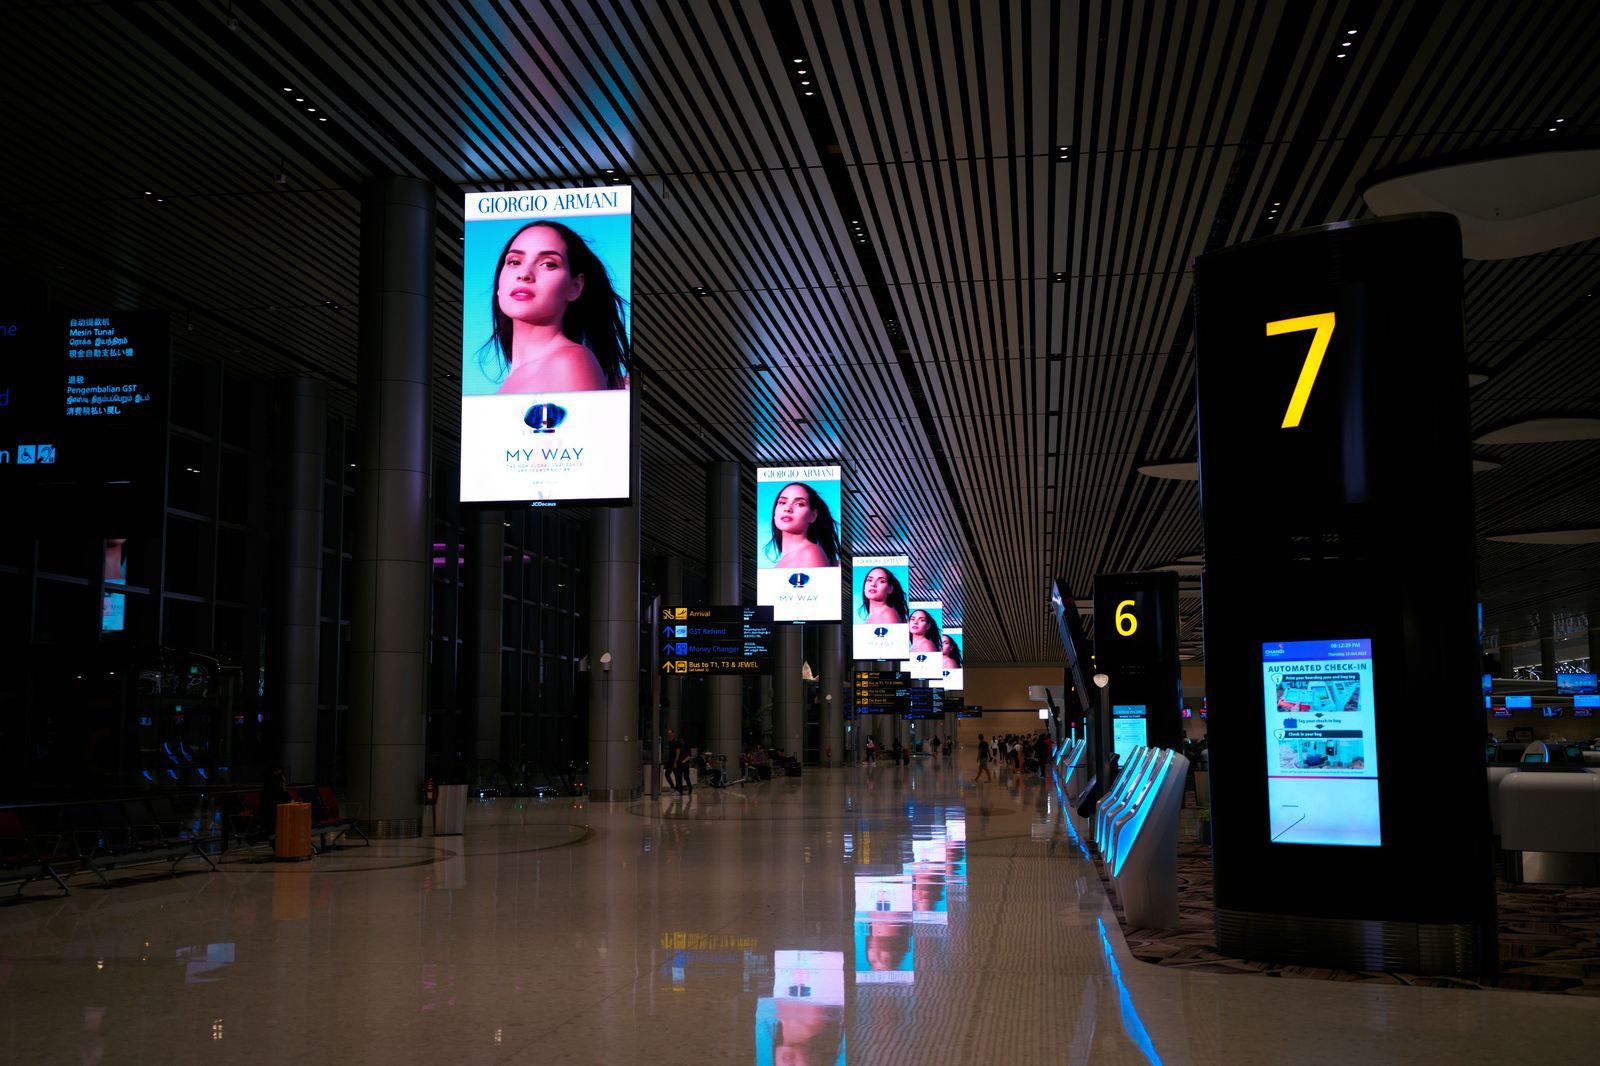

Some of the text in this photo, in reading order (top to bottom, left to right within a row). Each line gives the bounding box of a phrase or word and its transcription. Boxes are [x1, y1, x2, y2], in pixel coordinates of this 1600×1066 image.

[478, 192, 617, 214] GIORGIO ARMANI
[69, 327, 115, 337] Mesin Tunai
[1265, 312, 1336, 428] 7
[66, 384, 138, 395] Pengembalian GST
[506, 447, 584, 462] MY WAY
[763, 468, 834, 479] GIORGIO ARMANI
[1114, 599, 1138, 637] 6
[689, 646, 711, 654] Money
[712, 645, 739, 653] Changer
[710, 661, 720, 669] T1,
[1268, 663, 1367, 673] AUTOMATED CHECK-IN
